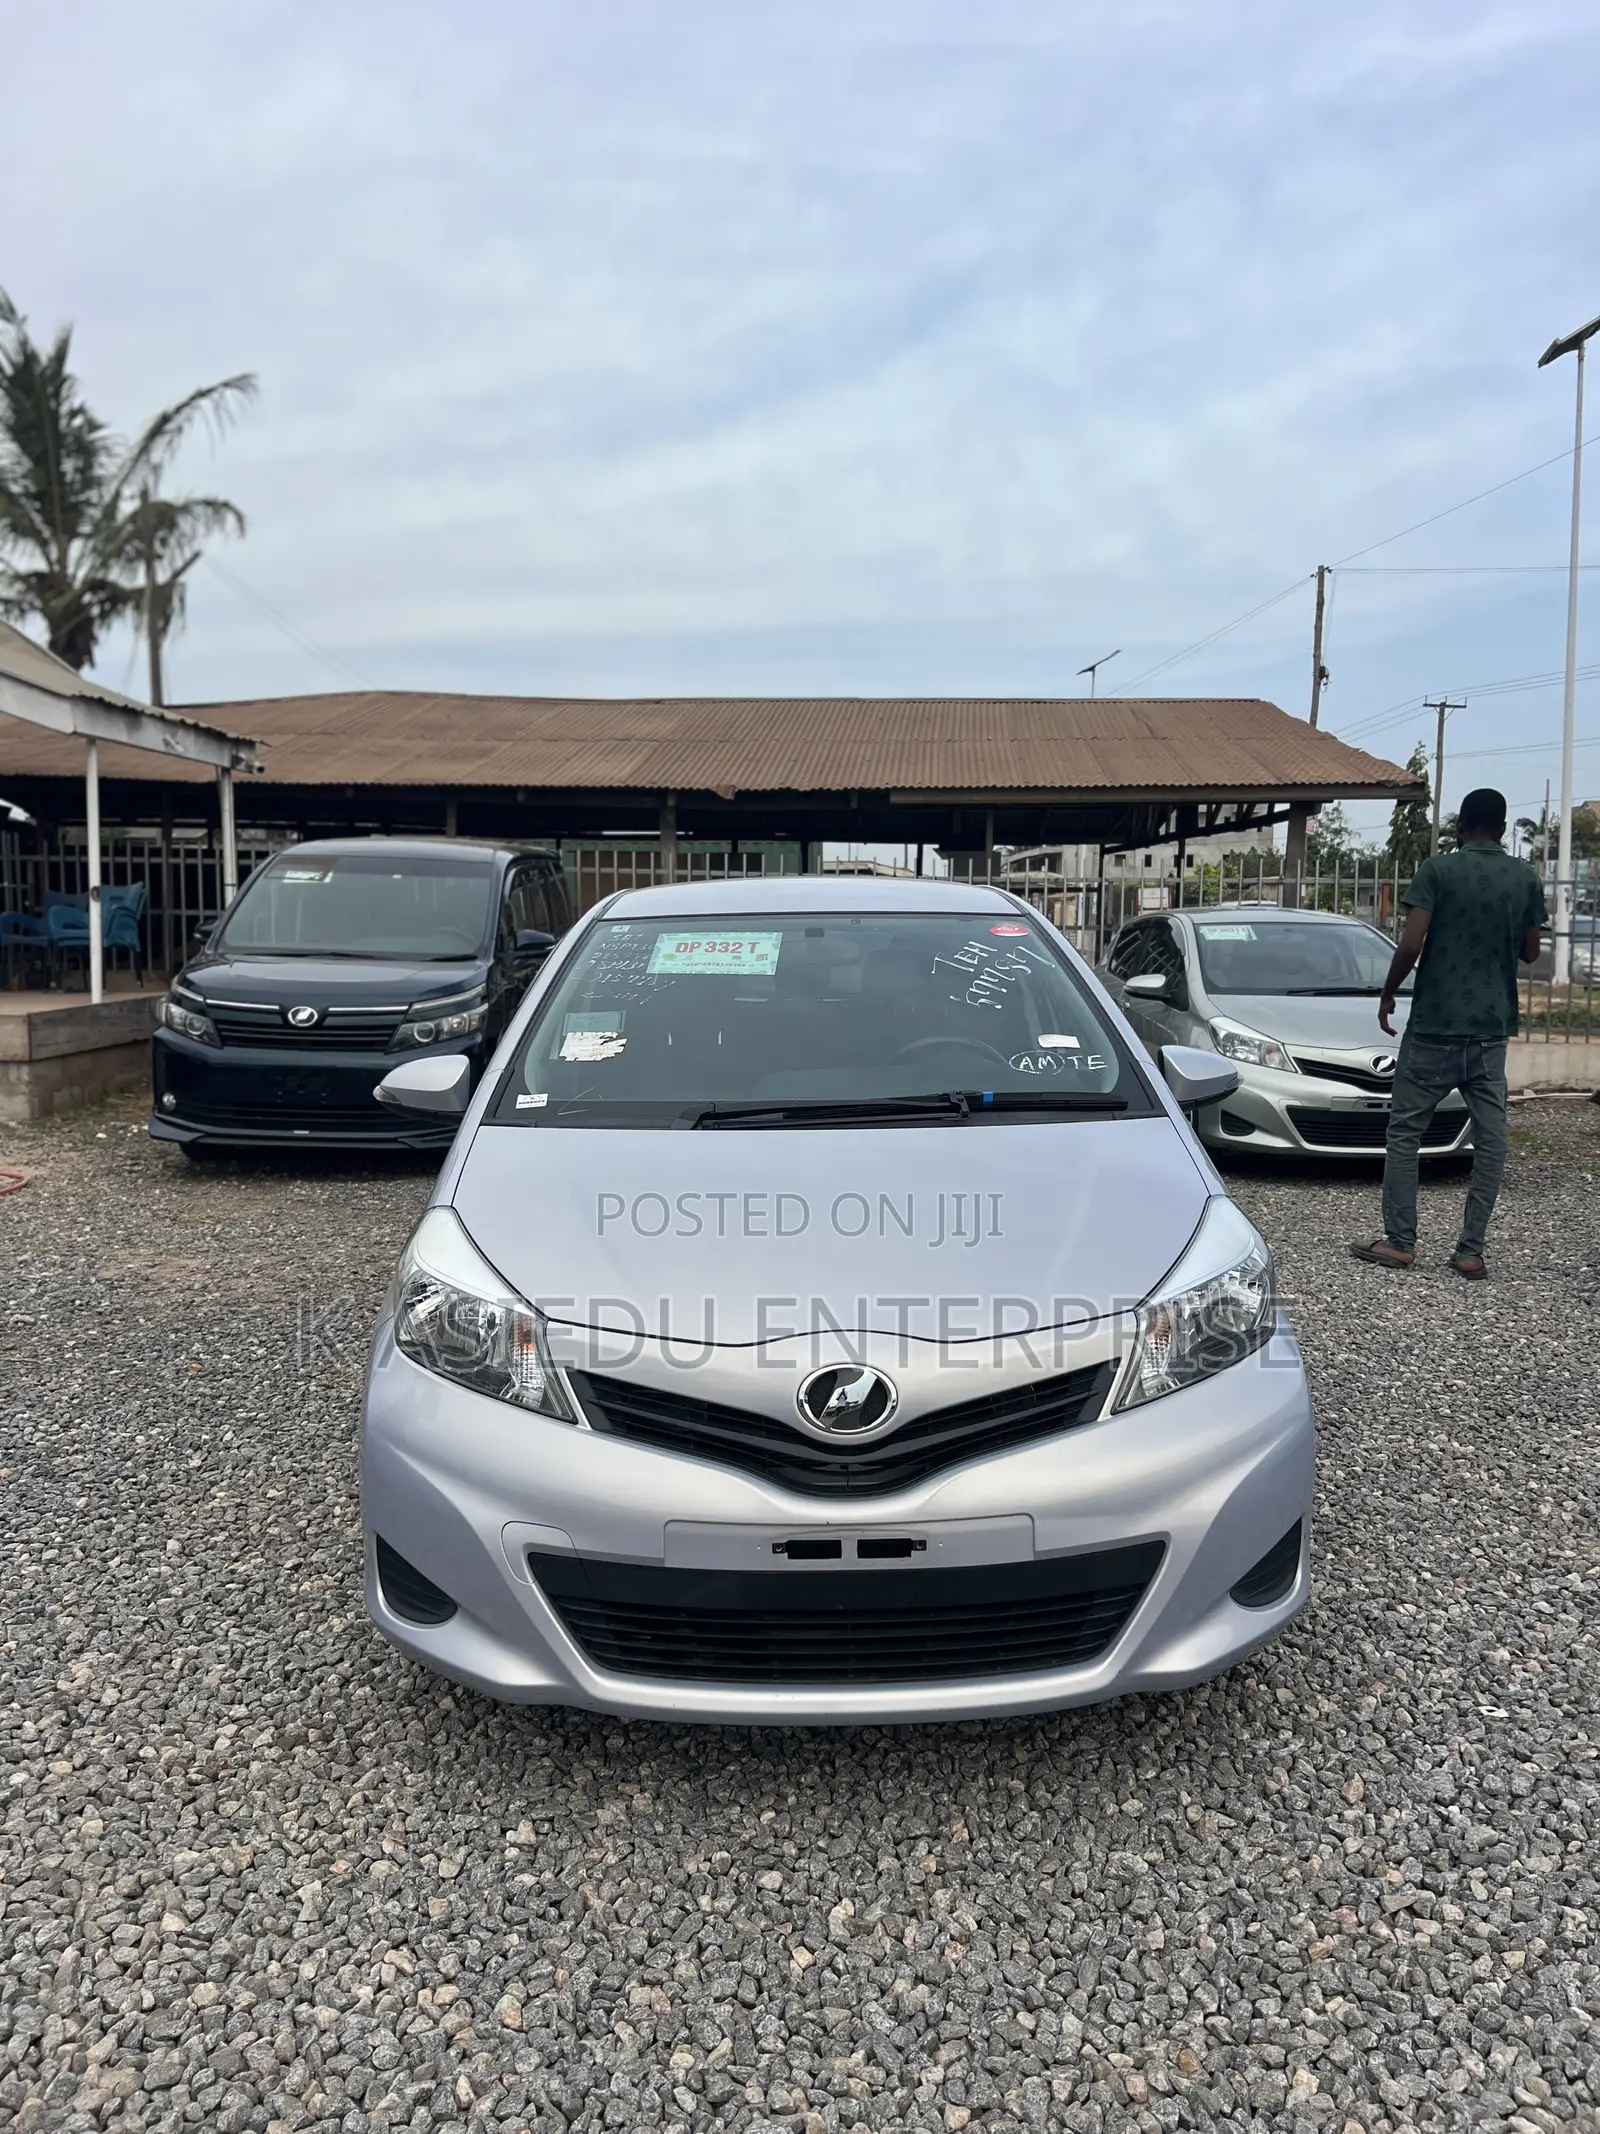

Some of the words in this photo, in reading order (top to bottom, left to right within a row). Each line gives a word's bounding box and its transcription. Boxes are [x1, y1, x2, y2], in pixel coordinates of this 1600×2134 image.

[675, 942, 702, 953] DP
[704, 941, 743, 954] 332
[748, 942, 760, 954] T
